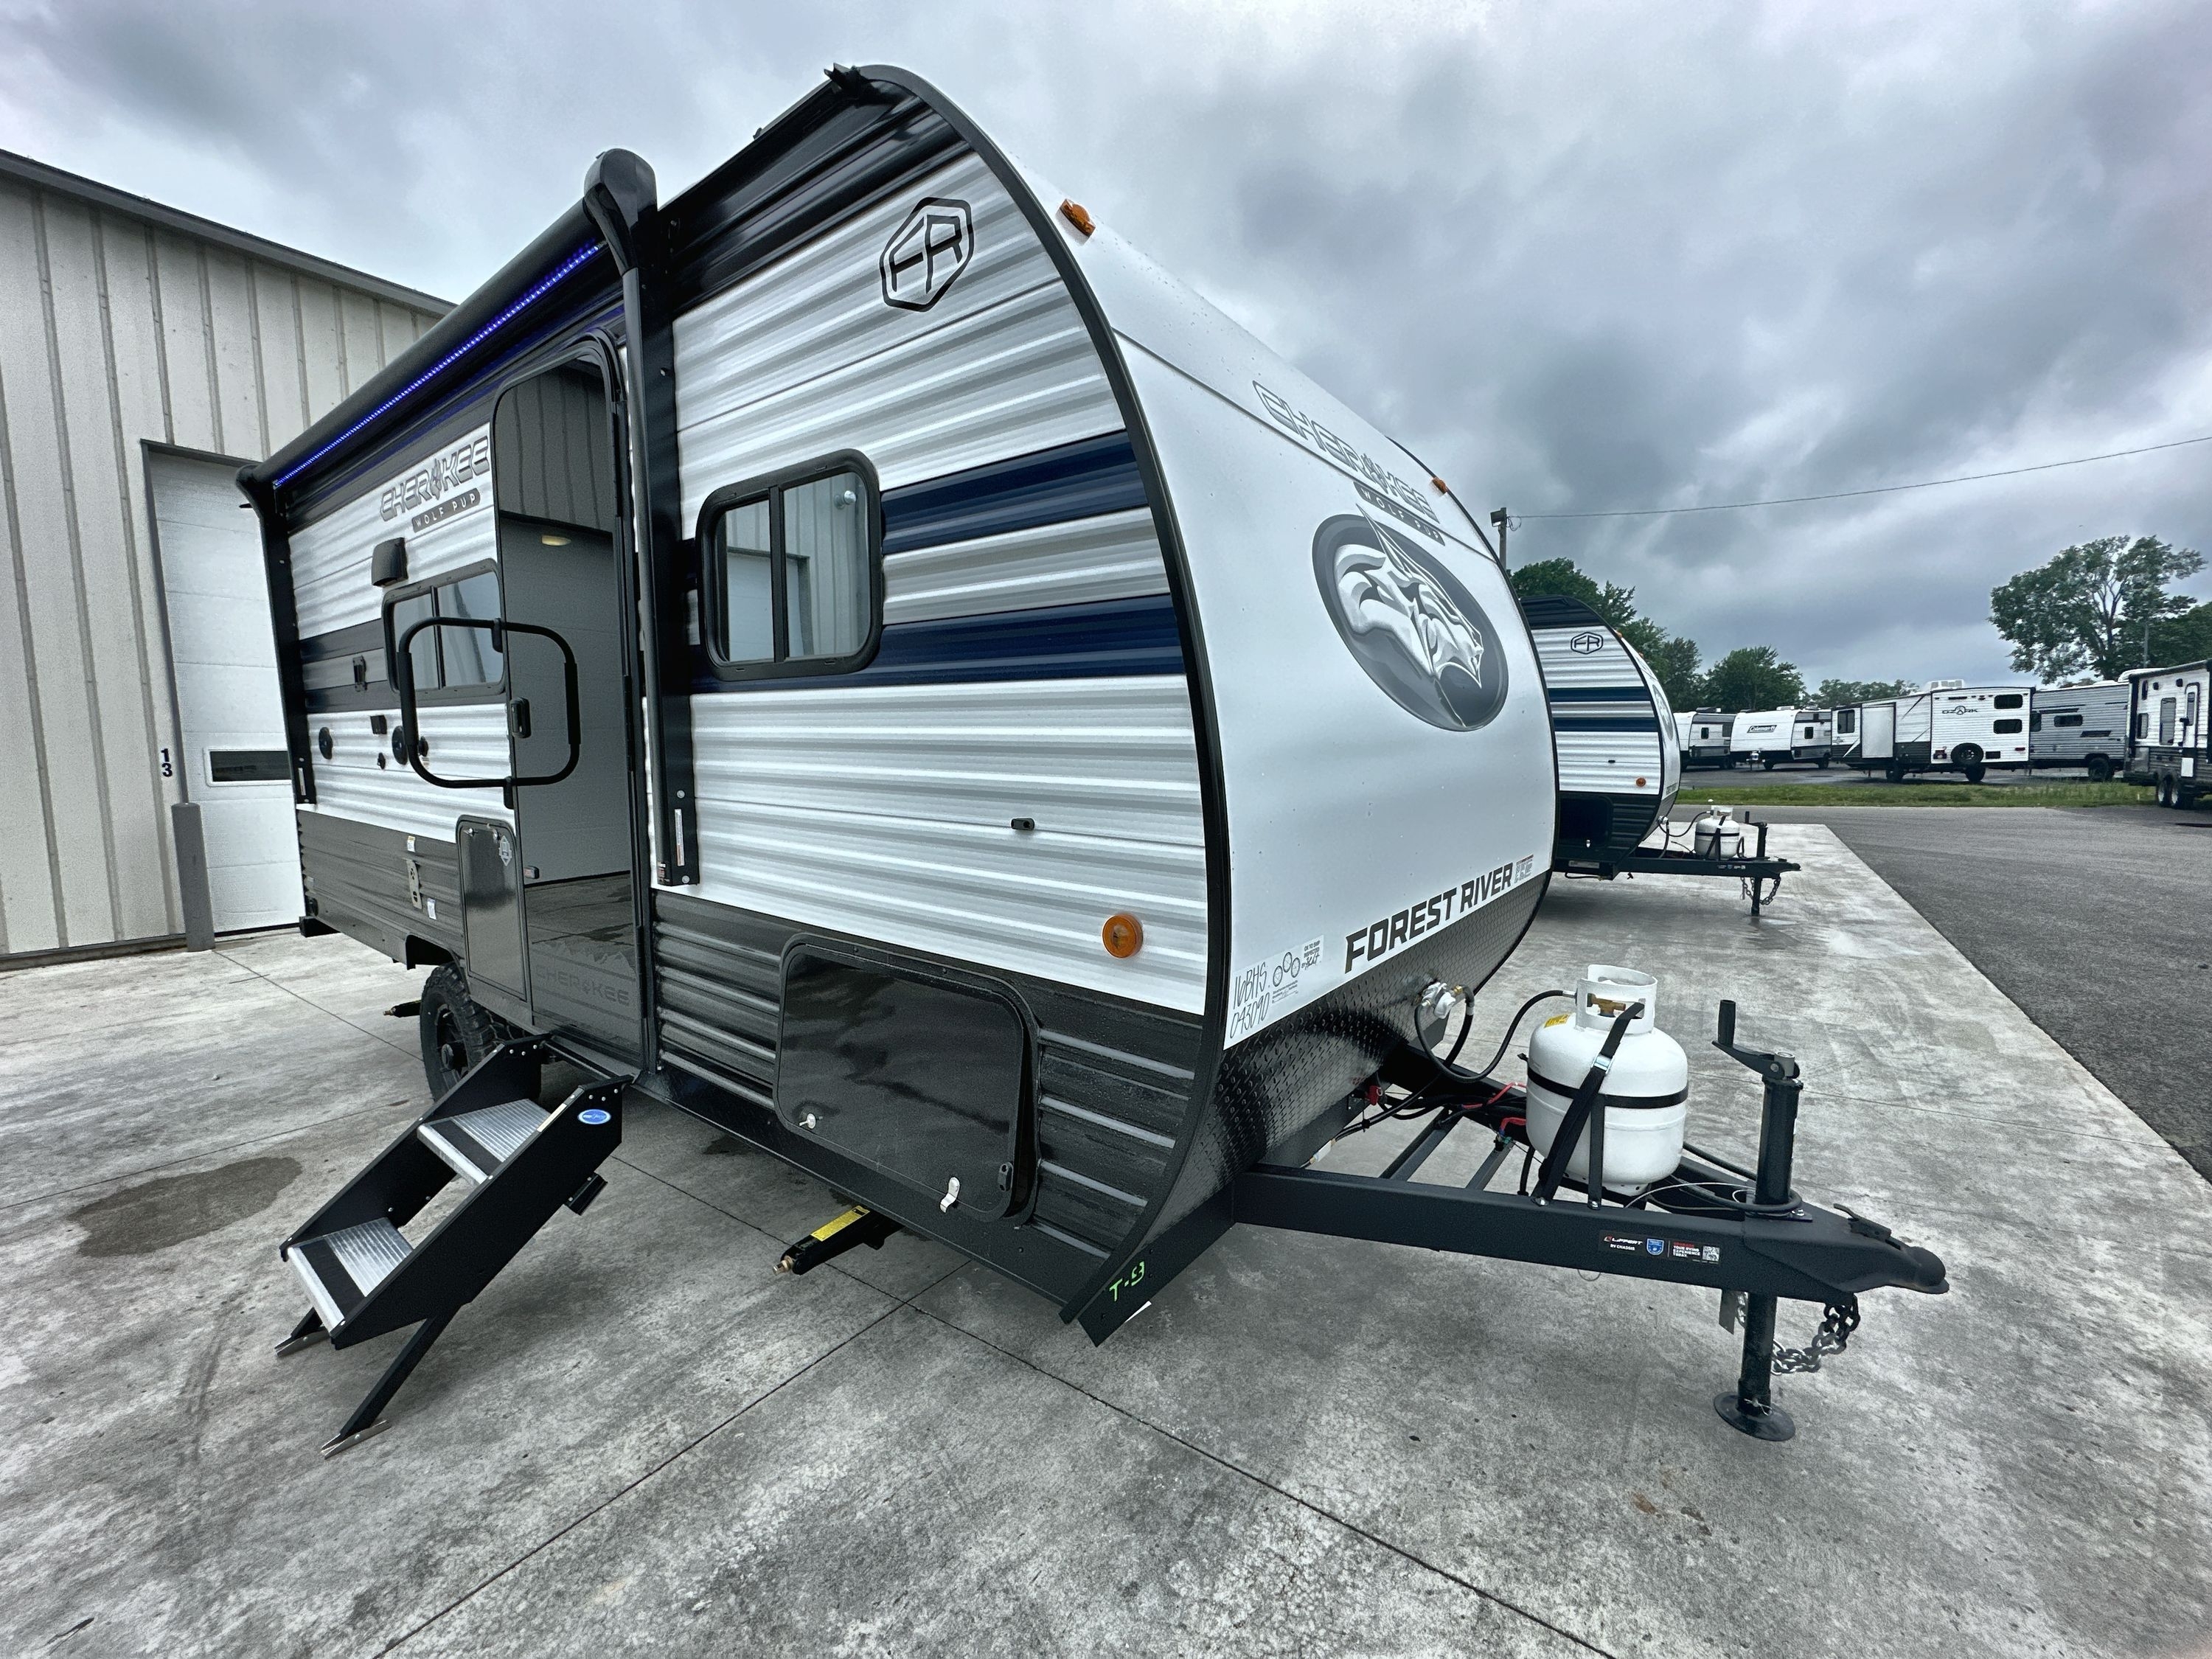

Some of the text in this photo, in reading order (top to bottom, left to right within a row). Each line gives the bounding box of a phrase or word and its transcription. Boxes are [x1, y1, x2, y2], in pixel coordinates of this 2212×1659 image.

[414, 493, 476, 527] WOLF PUP
[1360, 487, 1439, 540] WOLF PUP
[1344, 886, 1458, 974] FOREST
[1459, 862, 1514, 914] RIVER
[1229, 992, 1270, 1039] 043090
